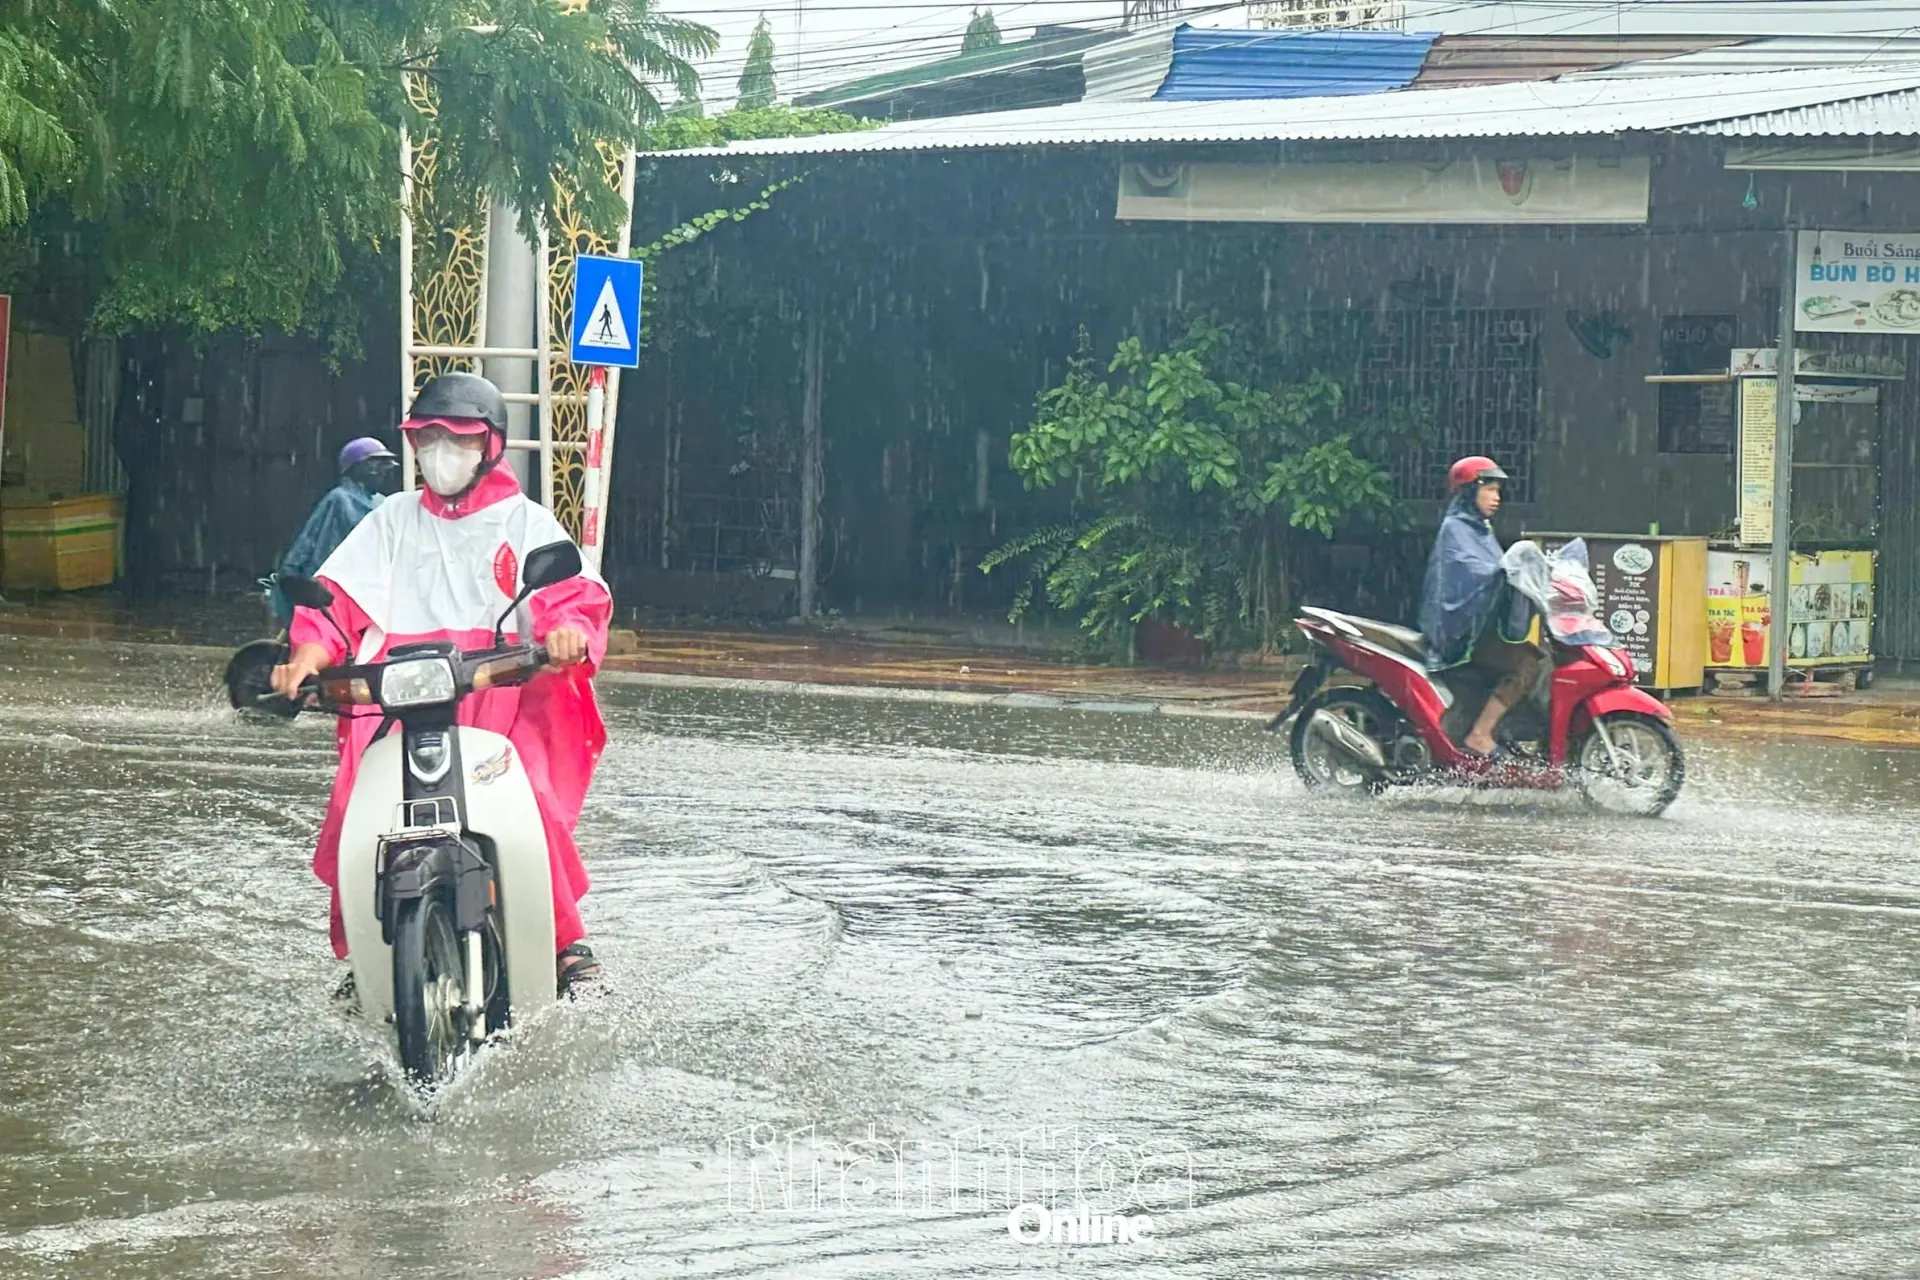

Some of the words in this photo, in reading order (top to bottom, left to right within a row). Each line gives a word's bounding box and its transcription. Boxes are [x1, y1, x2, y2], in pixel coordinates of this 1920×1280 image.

[1843, 240, 1878, 257] Buổi
[1810, 260, 1857, 281] BÚN
[1866, 261, 1896, 283] BÒ
